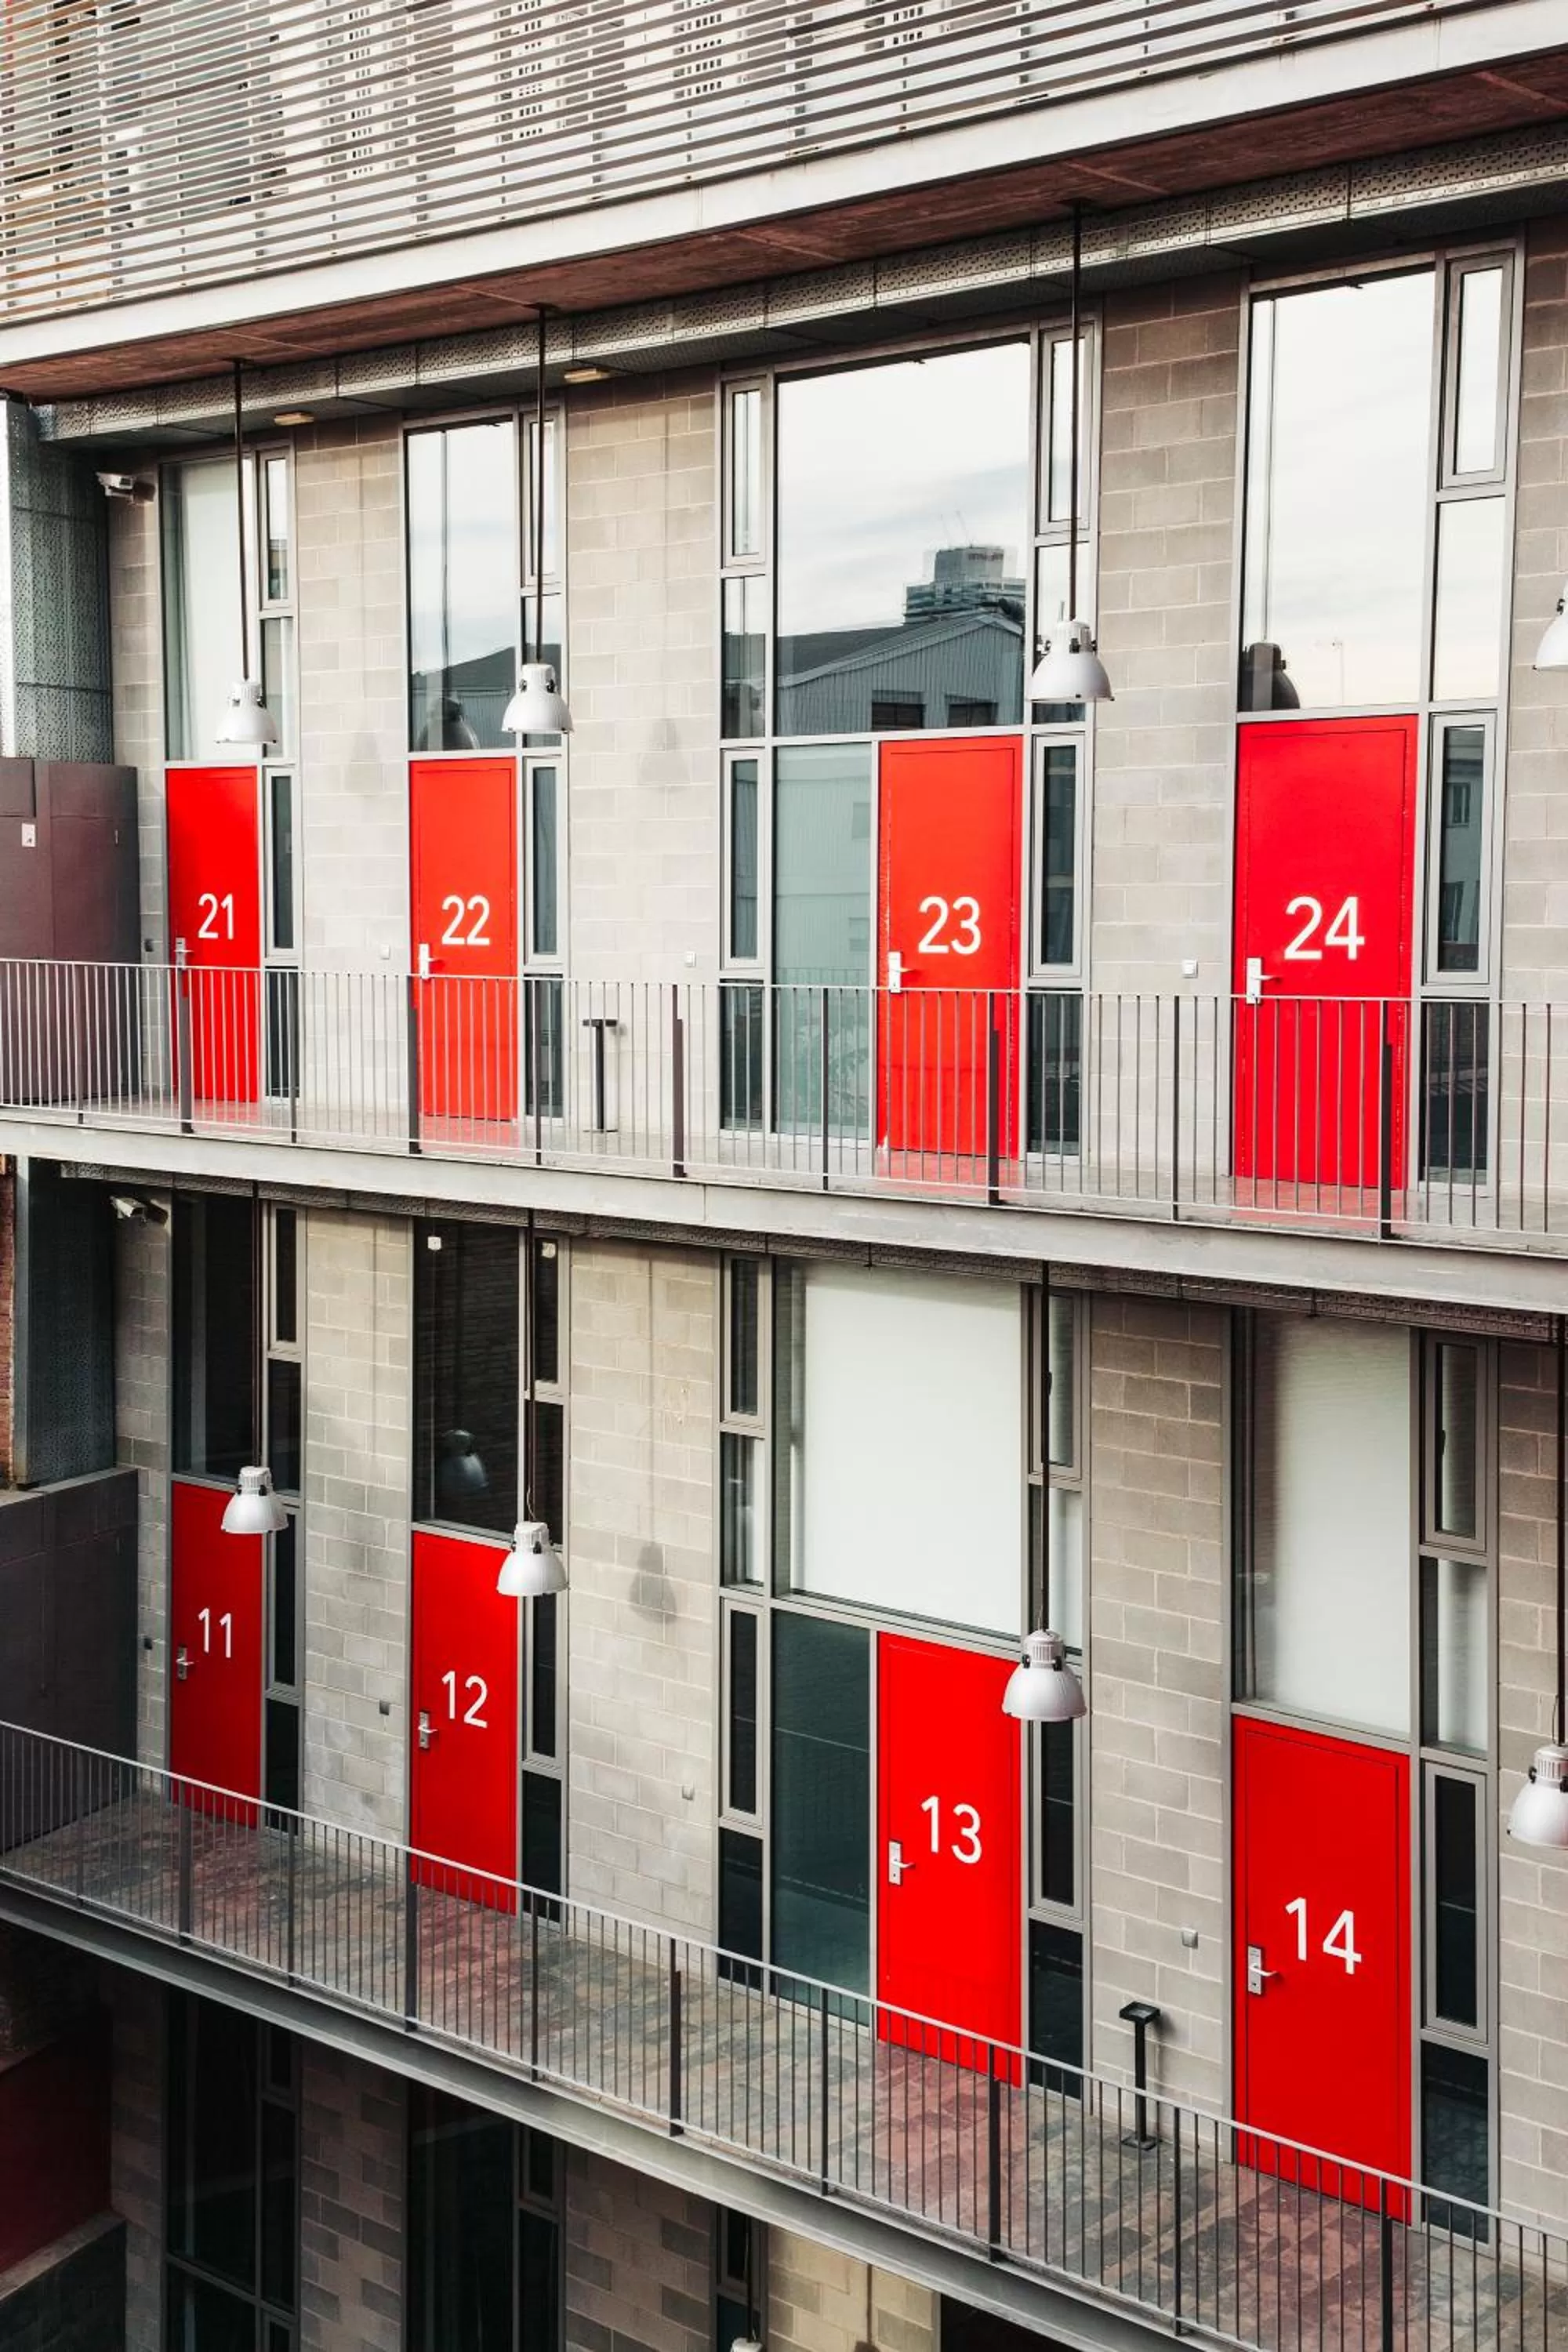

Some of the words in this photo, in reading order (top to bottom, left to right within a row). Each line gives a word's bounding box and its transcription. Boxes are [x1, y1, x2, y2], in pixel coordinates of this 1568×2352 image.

[198, 893, 234, 940] 21
[441, 894, 492, 946] 22
[917, 895, 982, 956] 23
[1283, 895, 1365, 960] 24
[198, 1608, 231, 1658] 11
[441, 1671, 488, 1729] 12
[921, 1795, 982, 1864] 13
[1285, 1897, 1362, 1975] 14
